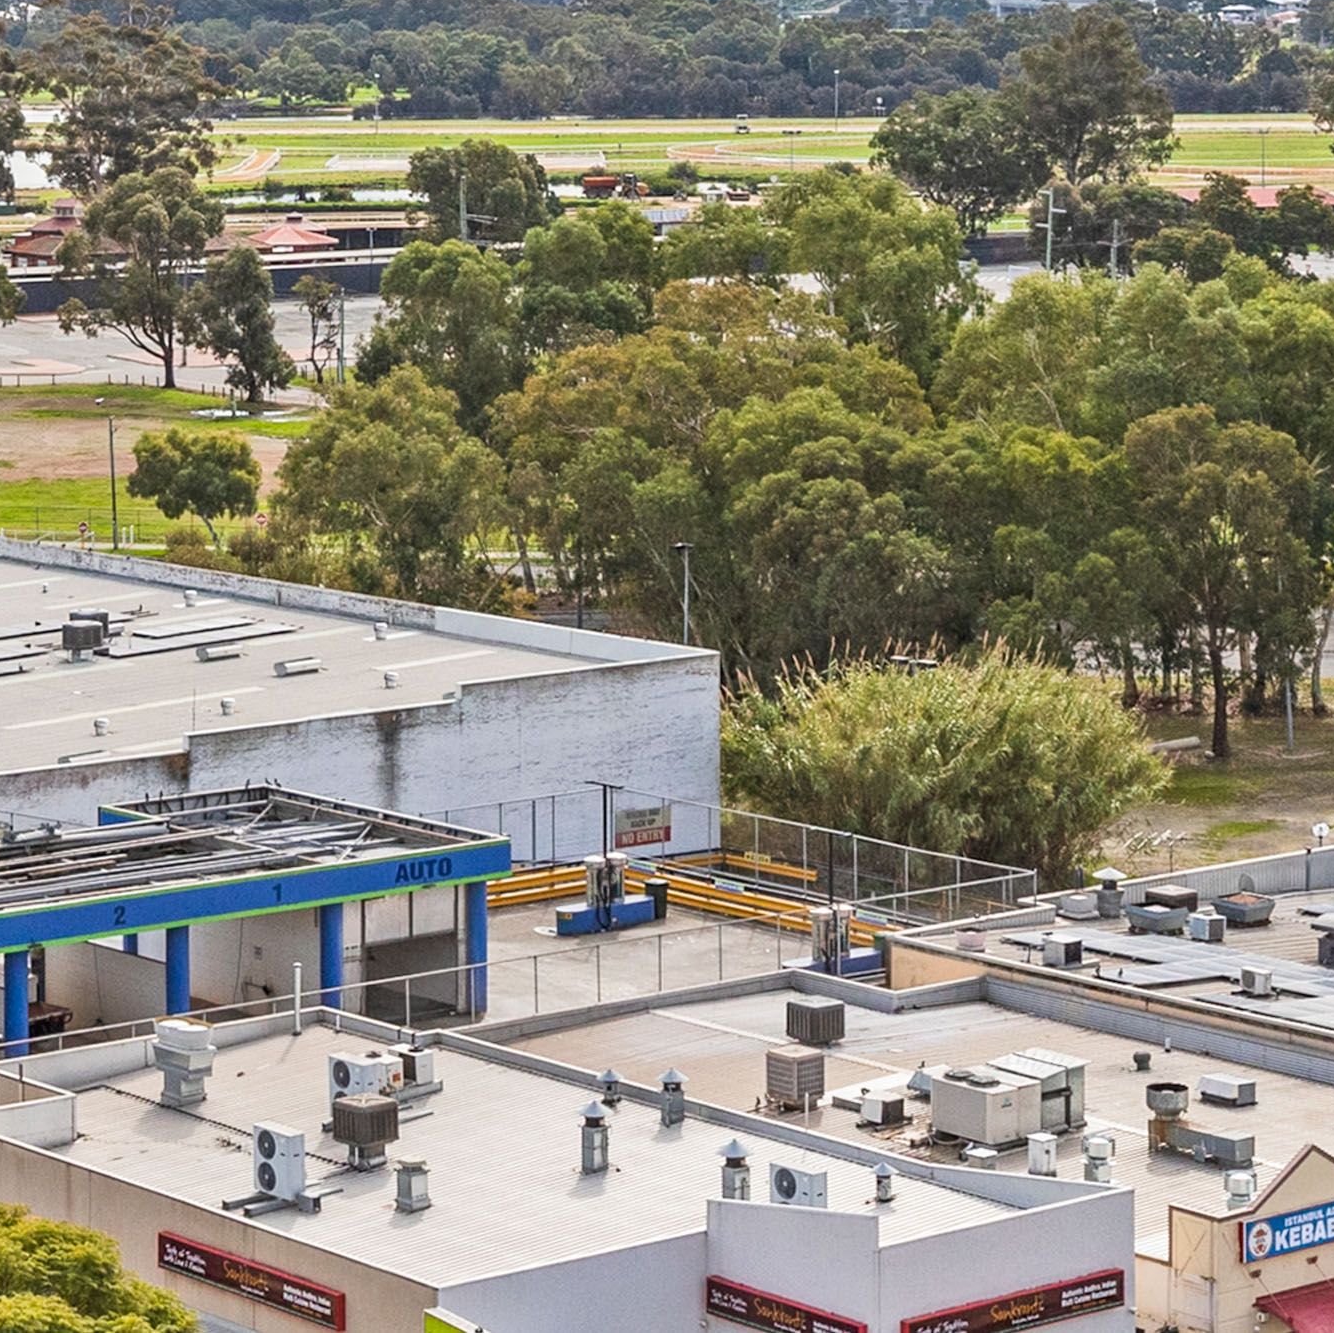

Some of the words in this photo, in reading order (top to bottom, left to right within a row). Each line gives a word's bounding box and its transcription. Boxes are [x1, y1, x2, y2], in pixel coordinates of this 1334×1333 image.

[621, 831, 635, 845] NO
[636, 828, 665, 843] ENTRY
[395, 857, 452, 884] AUTO
[272, 884, 282, 902] 1
[113, 906, 126, 925] 2
[1284, 1210, 1325, 1227] ISTANBUL
